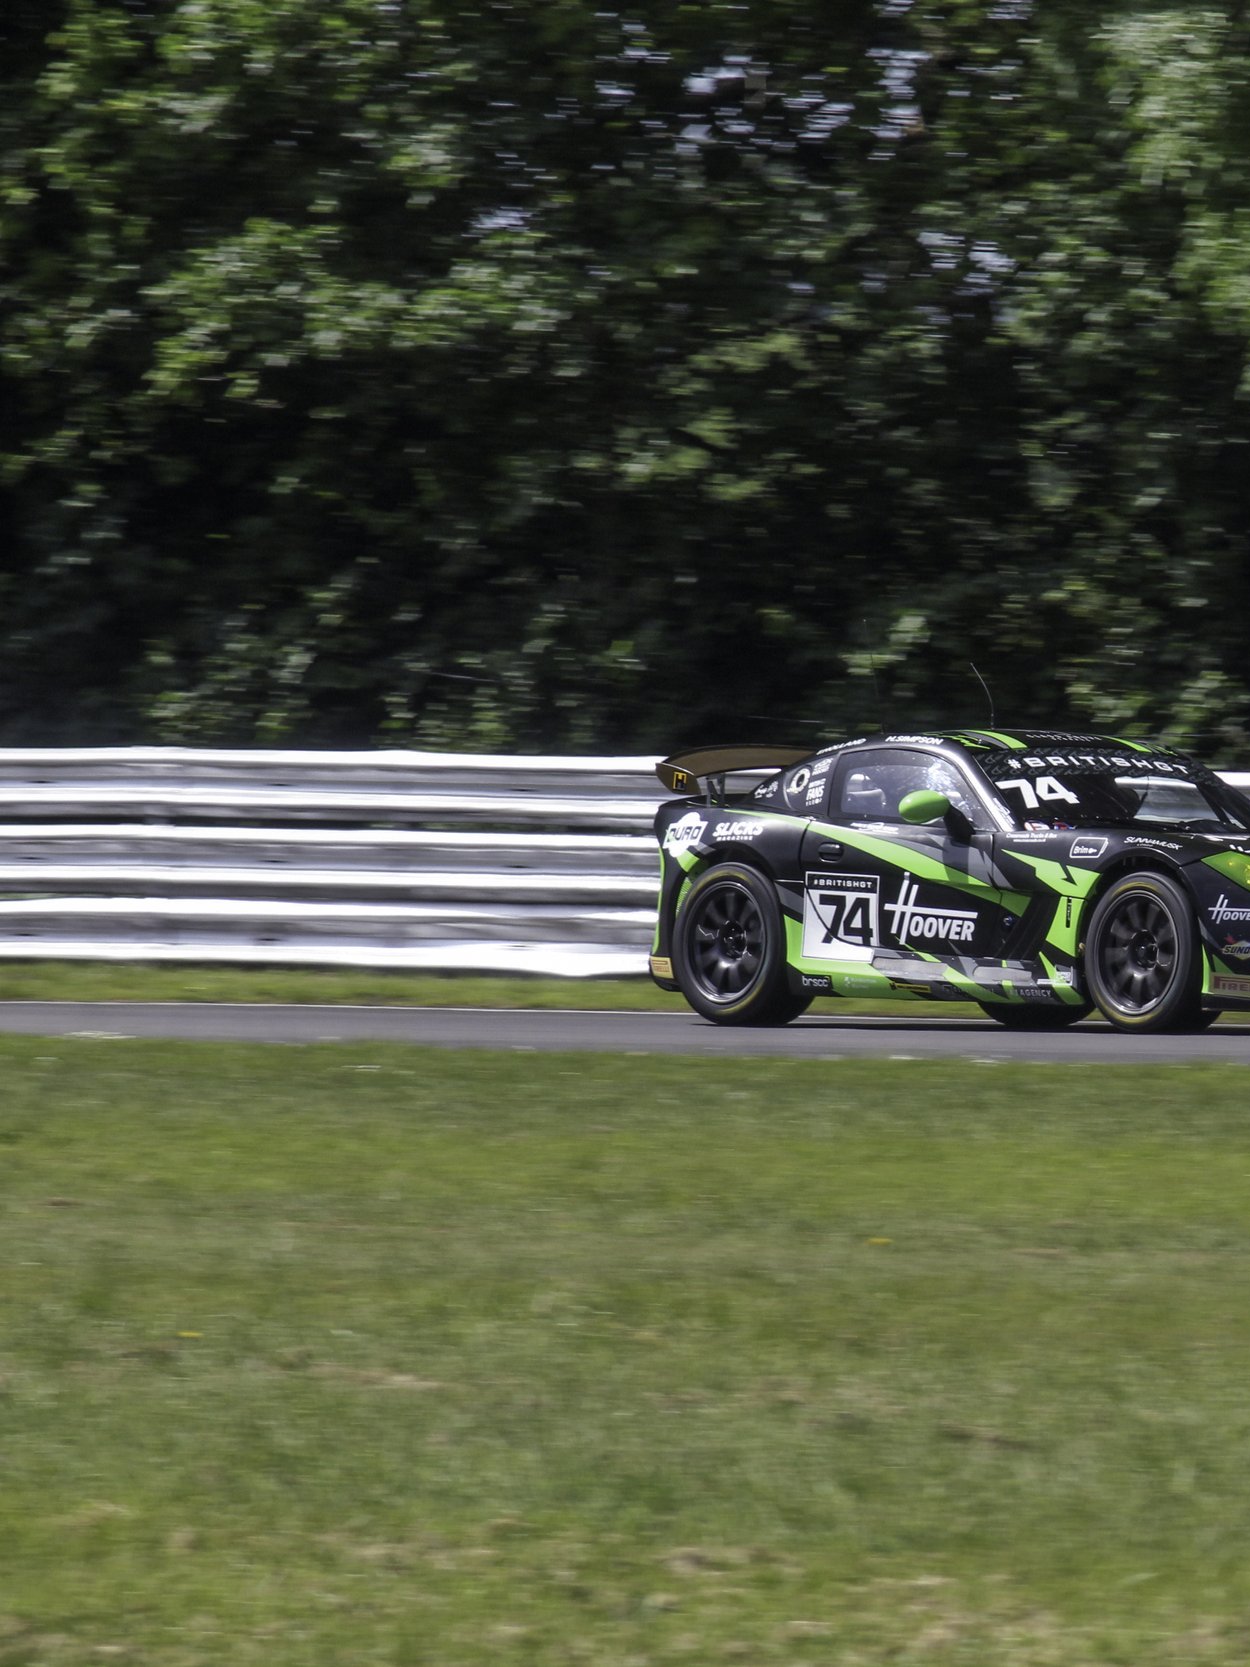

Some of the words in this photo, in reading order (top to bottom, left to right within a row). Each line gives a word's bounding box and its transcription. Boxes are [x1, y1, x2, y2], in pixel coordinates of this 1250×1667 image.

[1007, 756, 1189, 774] #BRITISHGT
[995, 775, 1081, 809] 74
[712, 822, 763, 837] SLICKS
[813, 878, 873, 889] #BRITISHGT
[884, 872, 978, 945] HOOVER
[819, 893, 874, 946] 74
[801, 975, 830, 988] brscc
[1020, 988, 1051, 997] AGENCY
